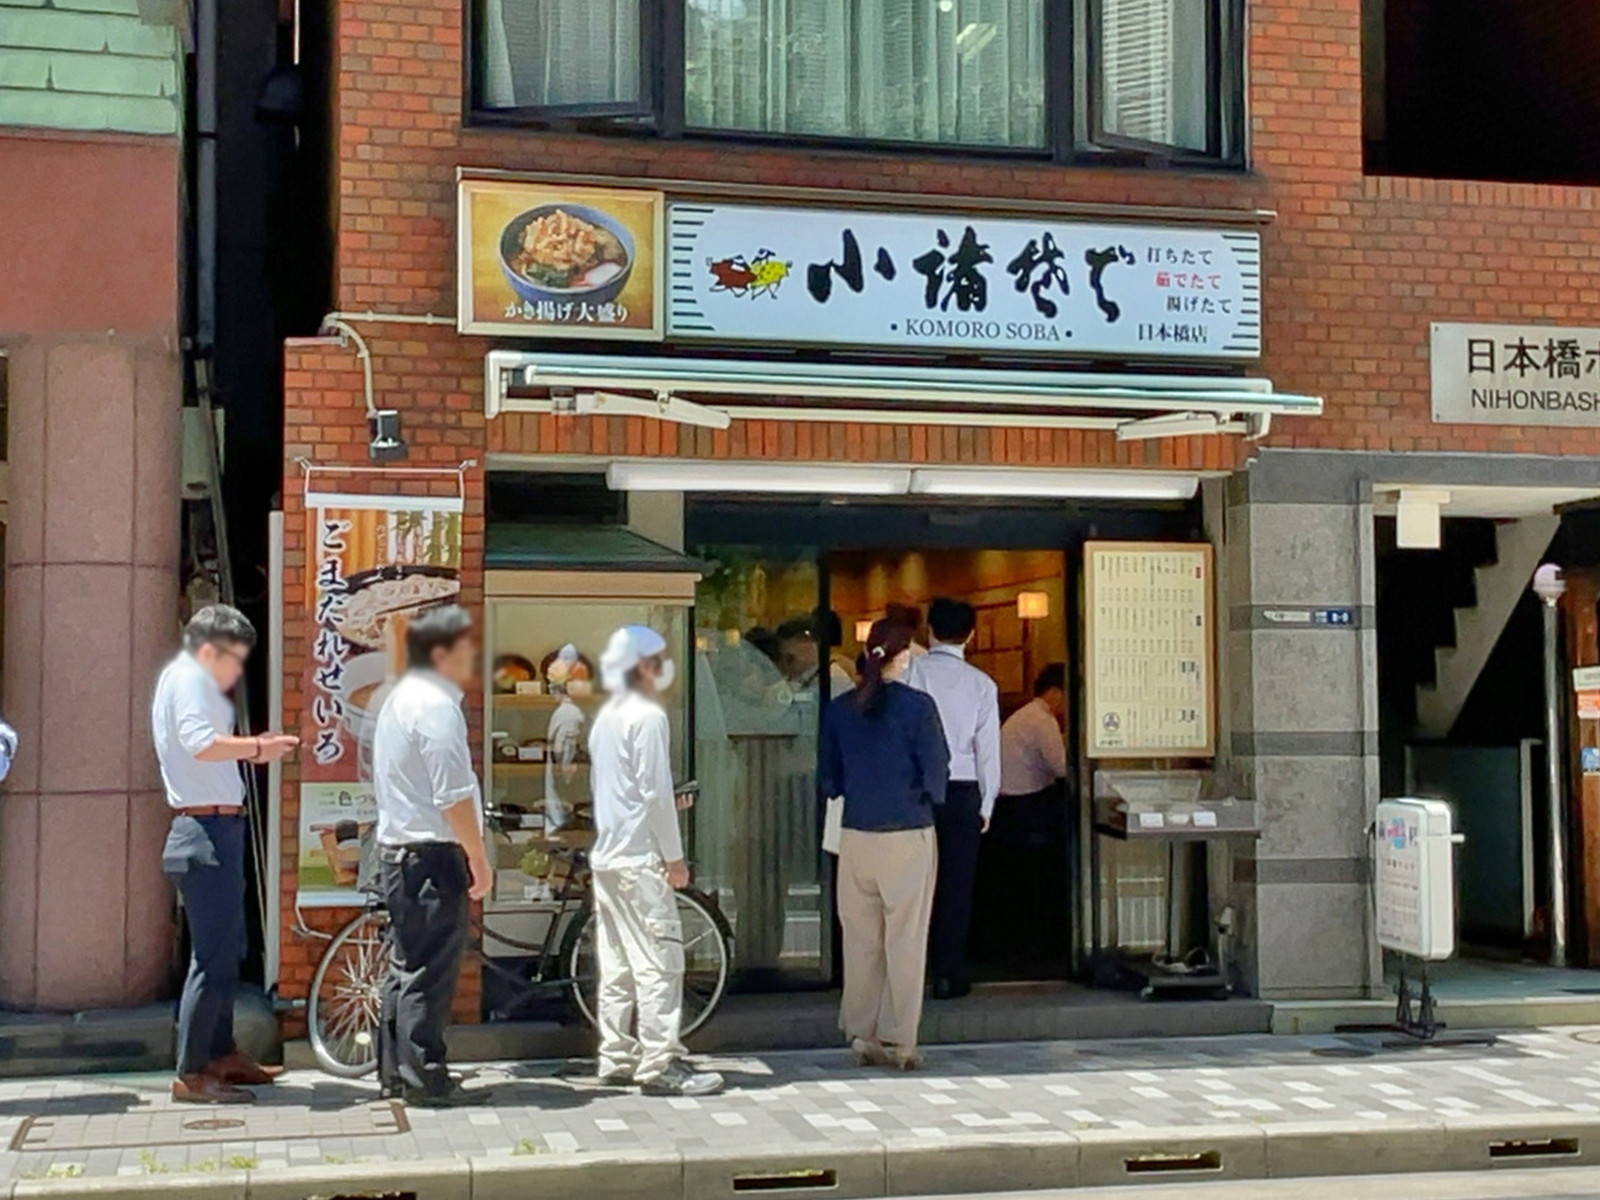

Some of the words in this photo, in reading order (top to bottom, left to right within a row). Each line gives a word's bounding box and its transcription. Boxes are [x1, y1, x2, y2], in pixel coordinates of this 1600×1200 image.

[1147, 246, 1213, 265] 打ちたて
[504, 301, 628, 323] かき揚げ大盛り
[1166, 295, 1232, 314] 揚げたて
[905, 320, 1001, 340] KOMORO
[1006, 325, 1060, 342] SOBA
[1138, 323, 1207, 343] 日本橋店
[314, 519, 351, 766] ごまだれせいろ
